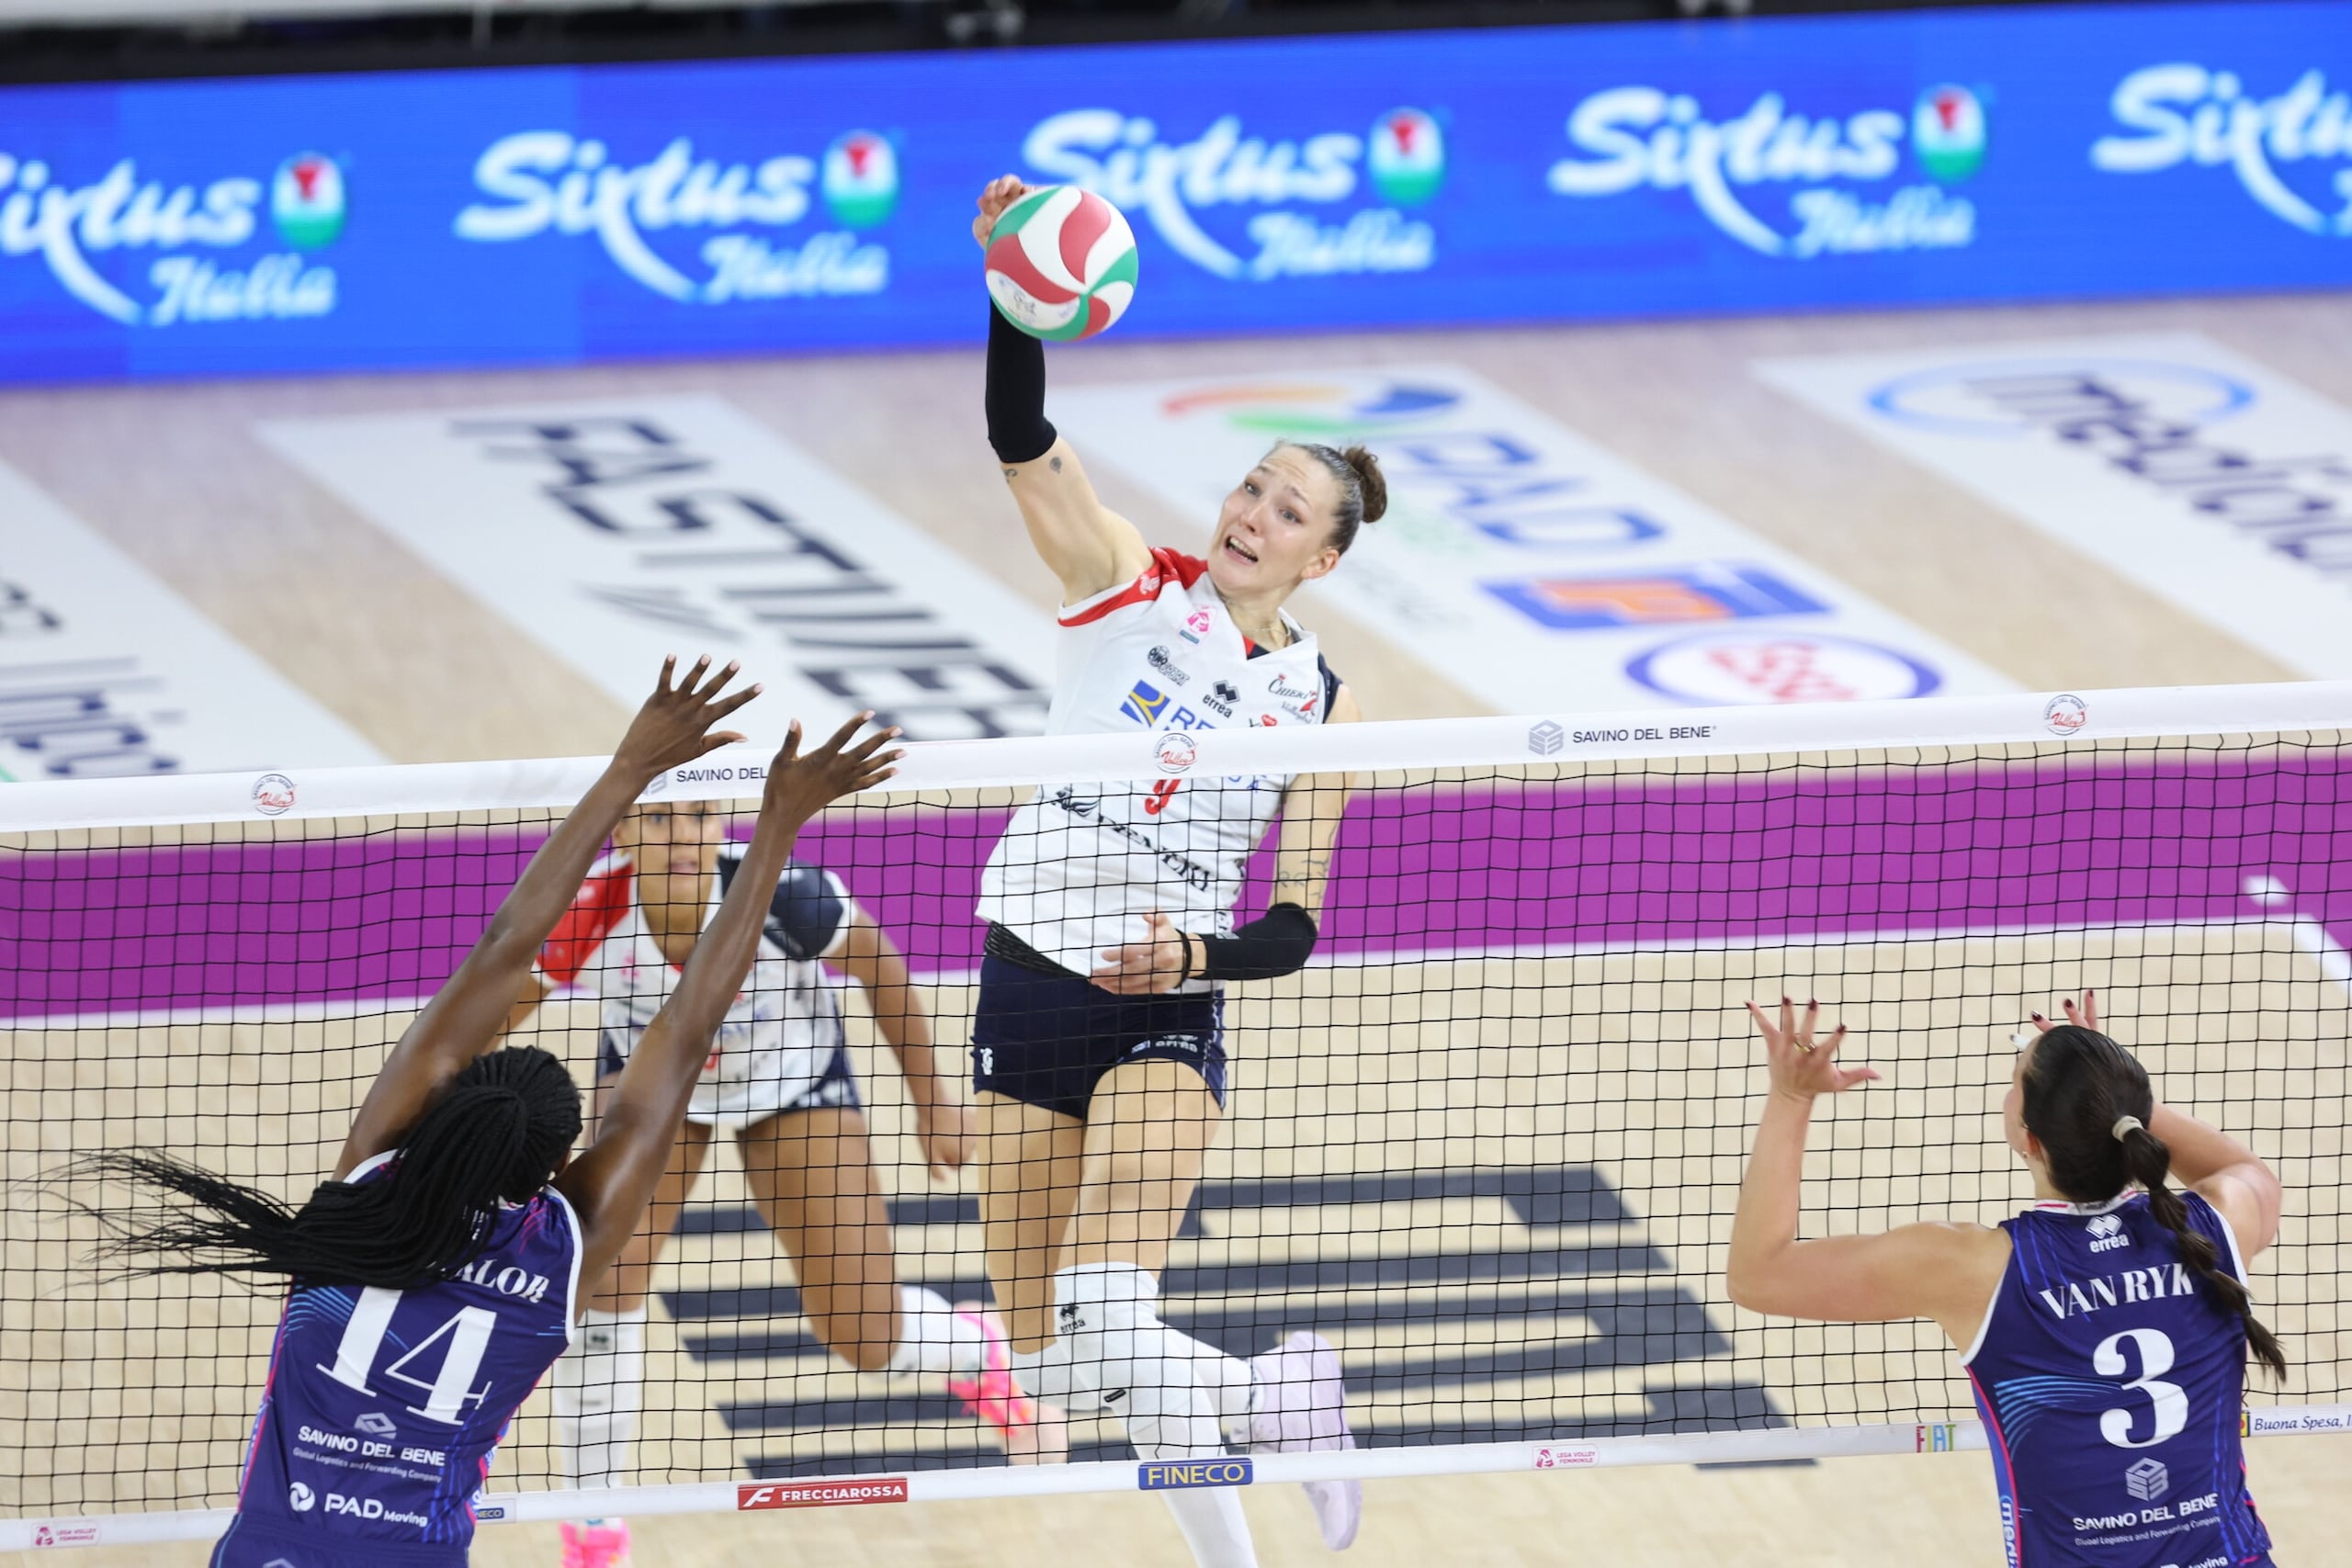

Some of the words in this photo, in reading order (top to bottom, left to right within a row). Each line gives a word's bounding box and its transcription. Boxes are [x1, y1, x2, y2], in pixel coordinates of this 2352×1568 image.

[1547, 85, 1905, 257] Sixtus
[451, 130, 816, 304] Sixtus
[1788, 185, 1977, 259] Italia
[0, 153, 262, 324] ixtus
[1247, 208, 1437, 281] Italia
[700, 231, 889, 305] Italia
[150, 254, 338, 326] Italia
[1202, 694, 1234, 719] errea
[1573, 728, 1629, 743] SAVINO
[1634, 728, 1663, 740] DEL
[676, 768, 733, 783] SAVINO
[739, 767, 769, 780] DEL
[2089, 1234, 2130, 1253] errea
[2038, 1274, 2118, 1320] VAN
[2120, 1263, 2195, 1303] RYK
[316, 1286, 497, 1426] 14
[2093, 1328, 2189, 1450] 3
[1916, 1424, 1957, 1453] FIAT
[2255, 1417, 2298, 1431] Buona
[2301, 1416, 2344, 1431] Spesa,
[298, 1425, 358, 1453] SAVINO
[362, 1440, 396, 1459] DEL
[401, 1447, 447, 1467] BENE
[781, 1485, 904, 1502] FRECCIAROSSA
[1148, 1463, 1245, 1486] FINECO
[324, 1492, 384, 1519] PAD
[383, 1509, 428, 1528] Moving
[2073, 1512, 2138, 1531] SAVINO
[2141, 1506, 2176, 1524] DEL
[2178, 1493, 2219, 1517] BENE
